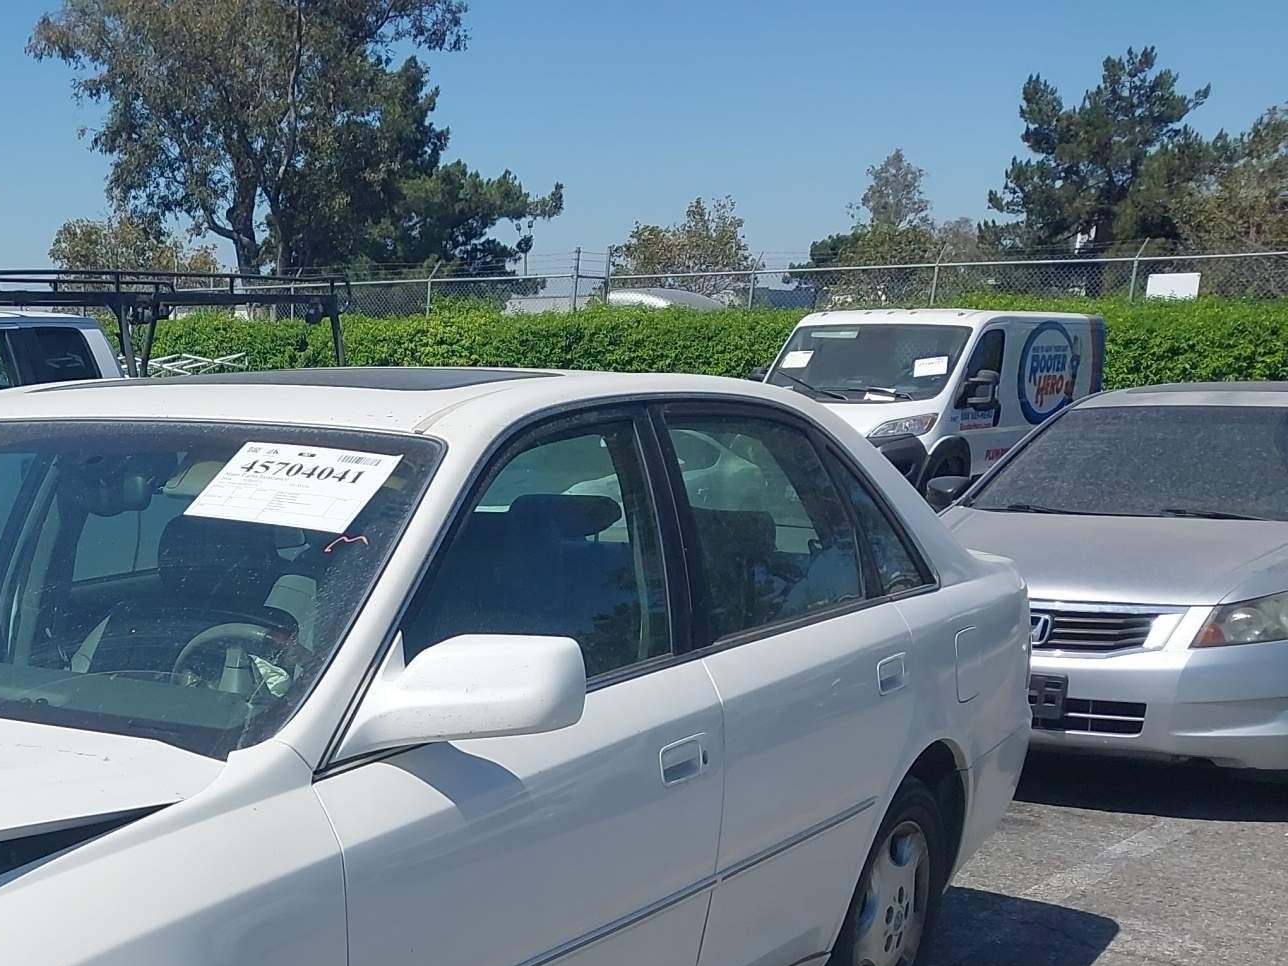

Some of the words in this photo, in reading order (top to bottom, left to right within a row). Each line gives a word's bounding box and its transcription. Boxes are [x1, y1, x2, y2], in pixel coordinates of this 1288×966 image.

[1029, 353, 1068, 386] ROOTER
[1035, 375, 1065, 407] HERO
[241, 459, 366, 484] 45704041
